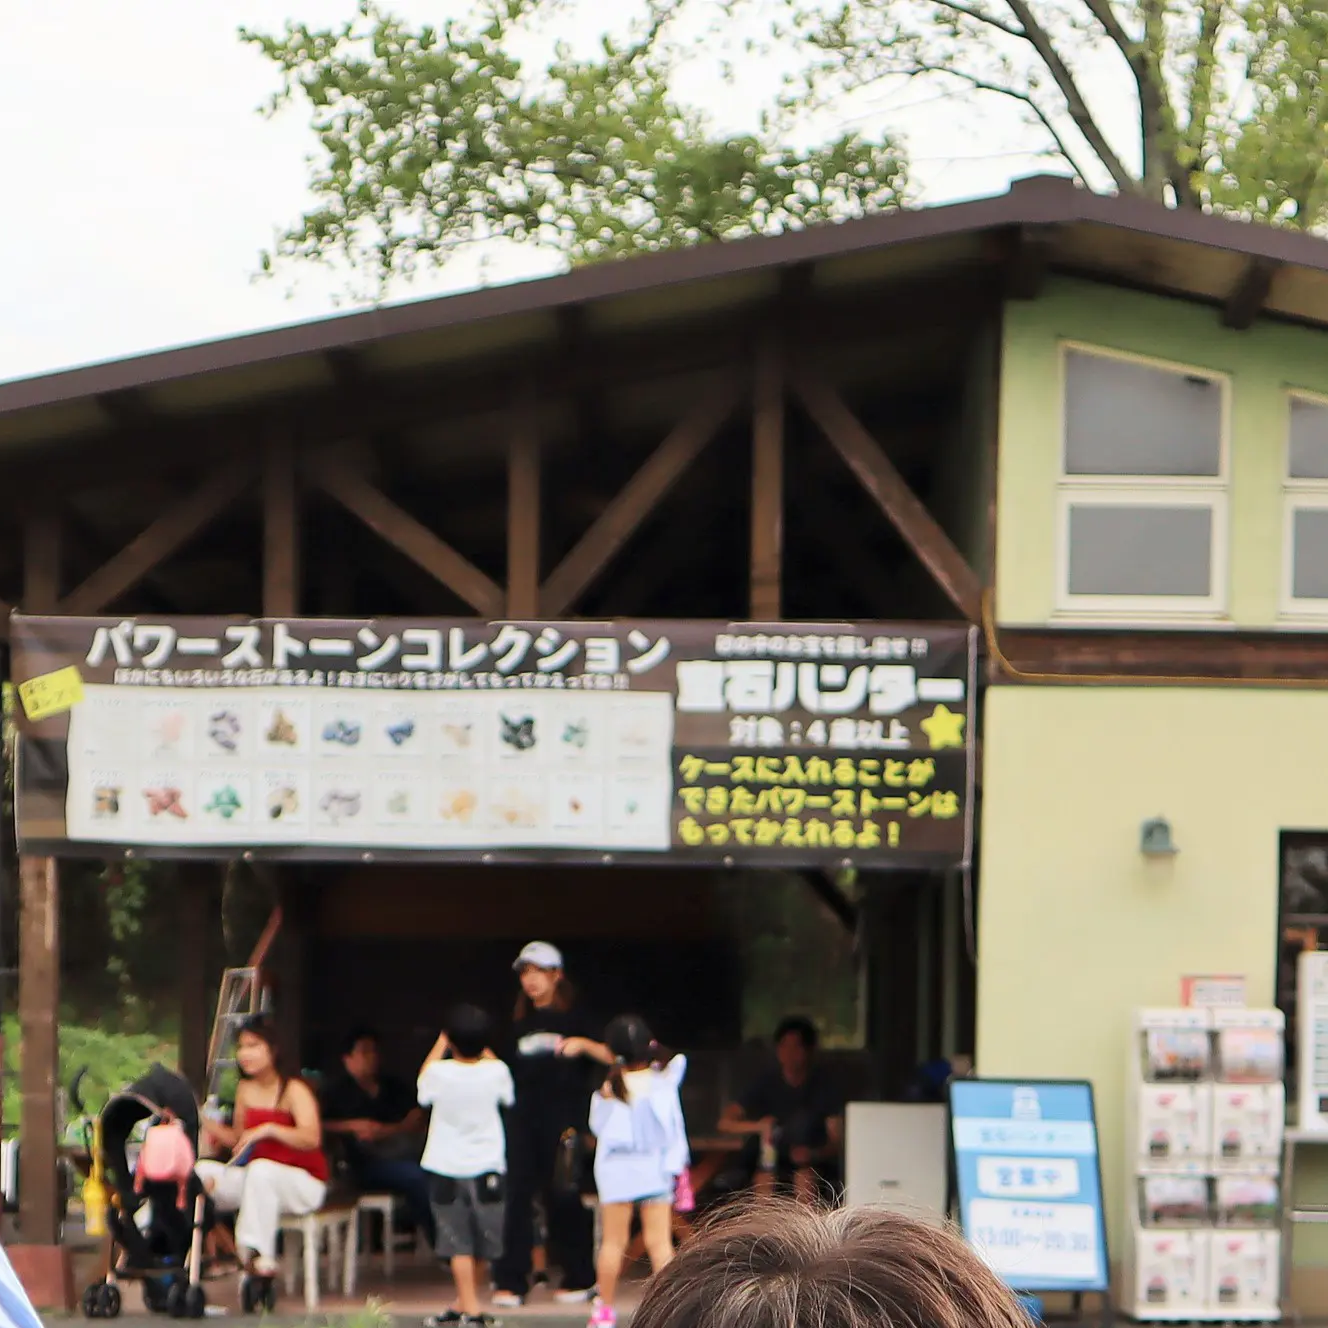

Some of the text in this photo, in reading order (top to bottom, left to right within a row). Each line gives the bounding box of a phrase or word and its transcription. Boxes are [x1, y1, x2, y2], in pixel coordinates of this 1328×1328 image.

[84, 620, 672, 675] パワーストーンコレクション
[679, 754, 935, 787] ケースに入れることが
[678, 785, 959, 819] できたパワーストーンは
